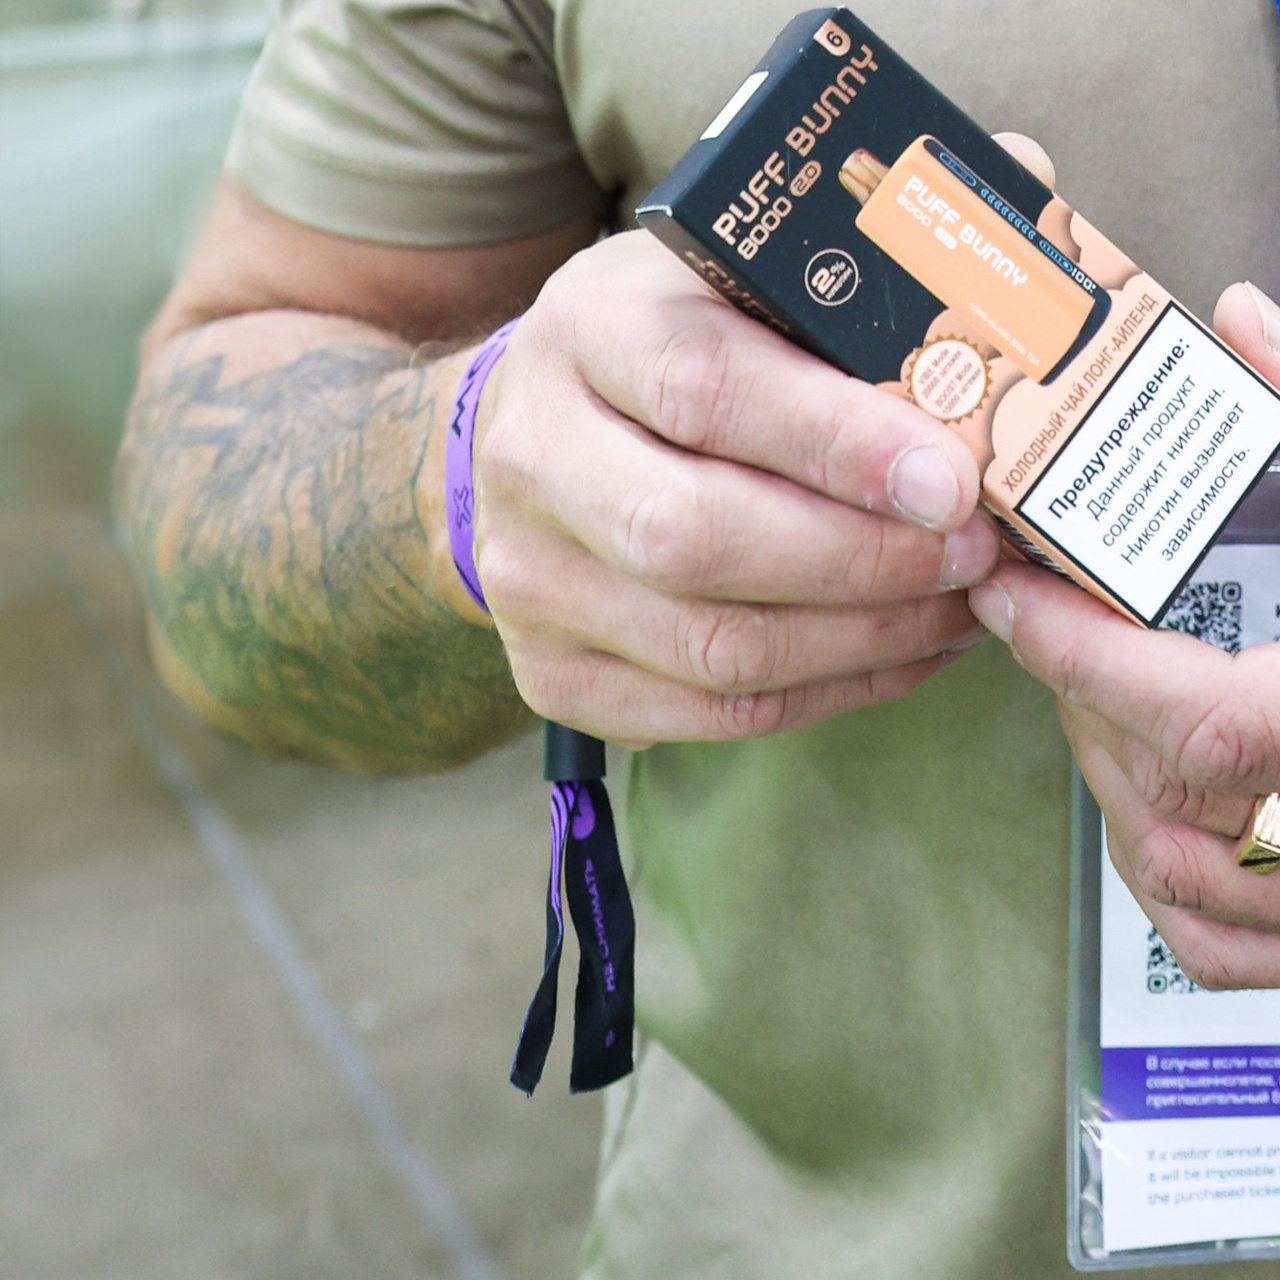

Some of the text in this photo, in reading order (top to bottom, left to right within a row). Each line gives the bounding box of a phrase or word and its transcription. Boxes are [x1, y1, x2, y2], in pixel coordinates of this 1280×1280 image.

[826, 29, 844, 48] 6
[712, 151, 786, 246] PUFF
[784, 44, 879, 158] BUNNY
[737, 196, 792, 261] 8000
[904, 174, 1029, 287] PUFF BUNNY
[1002, 293, 1159, 492] ХОЛОДНЫЙ ЧАЙ ЛОНГ-АЙЛЕНД
[1048, 338, 1190, 520] Предупреждение:
[1086, 374, 1197, 522] Данный продукт
[1103, 388, 1226, 547] содержит никотин.
[1120, 401, 1245, 565] Никотин вызывает
[1161, 448, 1251, 562] зависимость.
[1148, 1193, 1169, 1205] the
[1174, 1187, 1244, 1204] purchased
[1172, 1148, 1211, 1160] visitor
[1216, 1146, 1262, 1158] cannot
[1185, 1169, 1200, 1181] be
[1206, 1165, 1275, 1179] impossible
